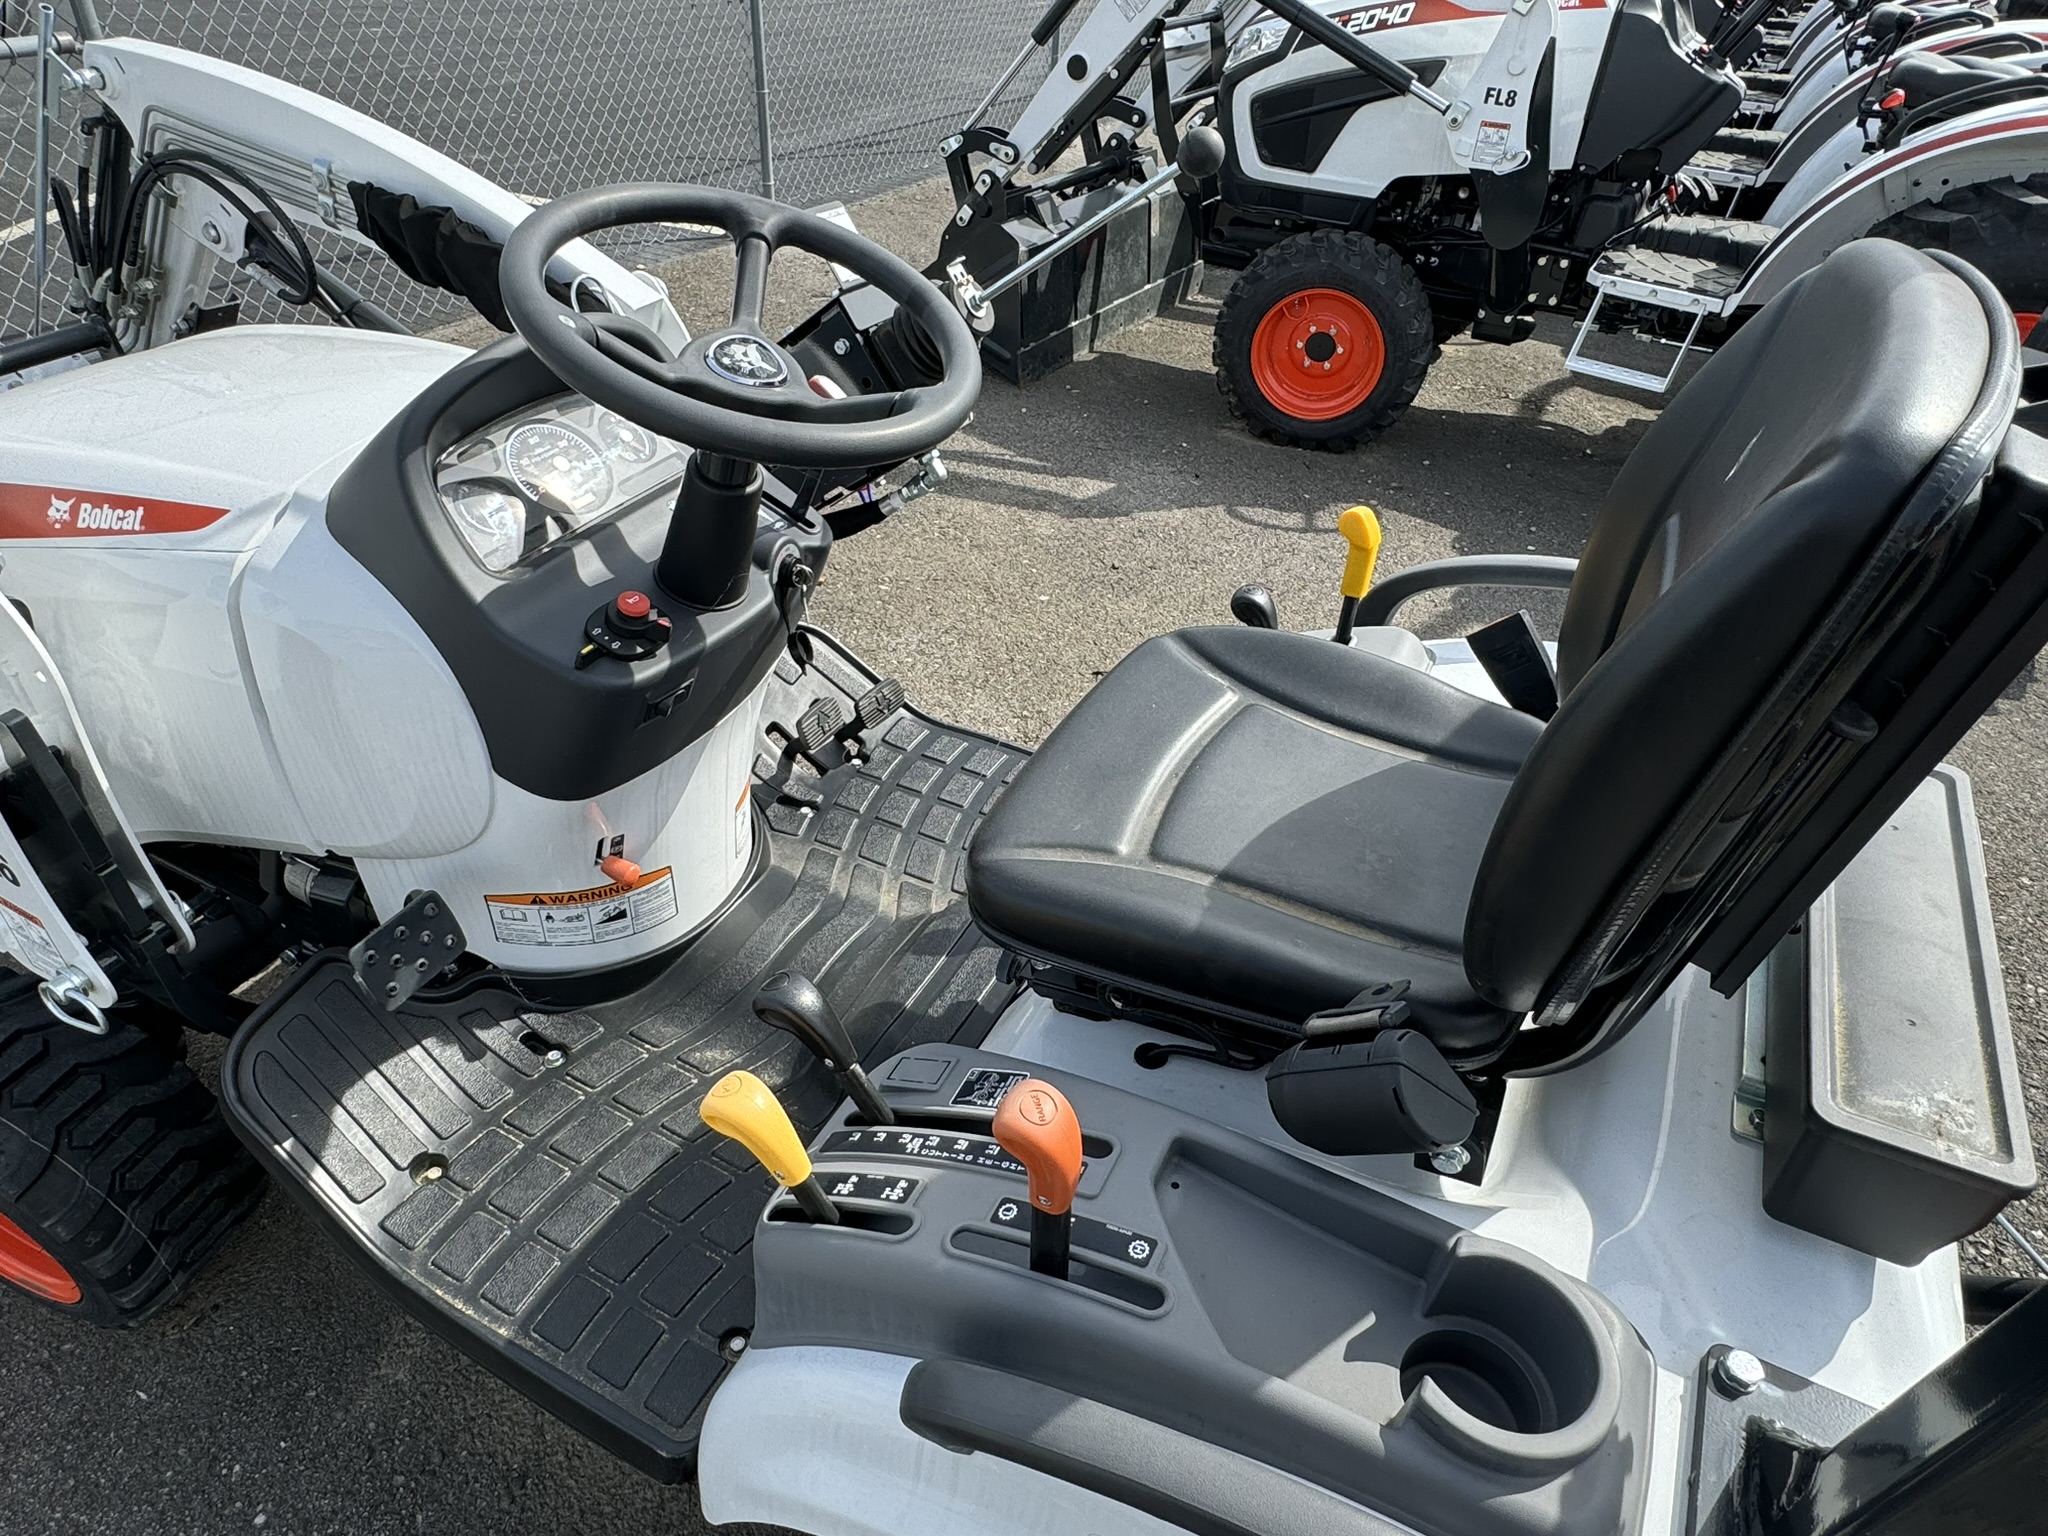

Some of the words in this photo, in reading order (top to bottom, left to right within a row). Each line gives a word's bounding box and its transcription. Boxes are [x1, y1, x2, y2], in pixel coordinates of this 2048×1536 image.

[1483, 87, 1518, 108] FL8
[77, 502, 144, 531] Bobcat
[548, 883, 633, 904] WARNING
[1030, 1093, 1047, 1123] RANGE
[921, 1148, 974, 1161] CUTTING
[977, 1156, 1026, 1172] HEIGHT
